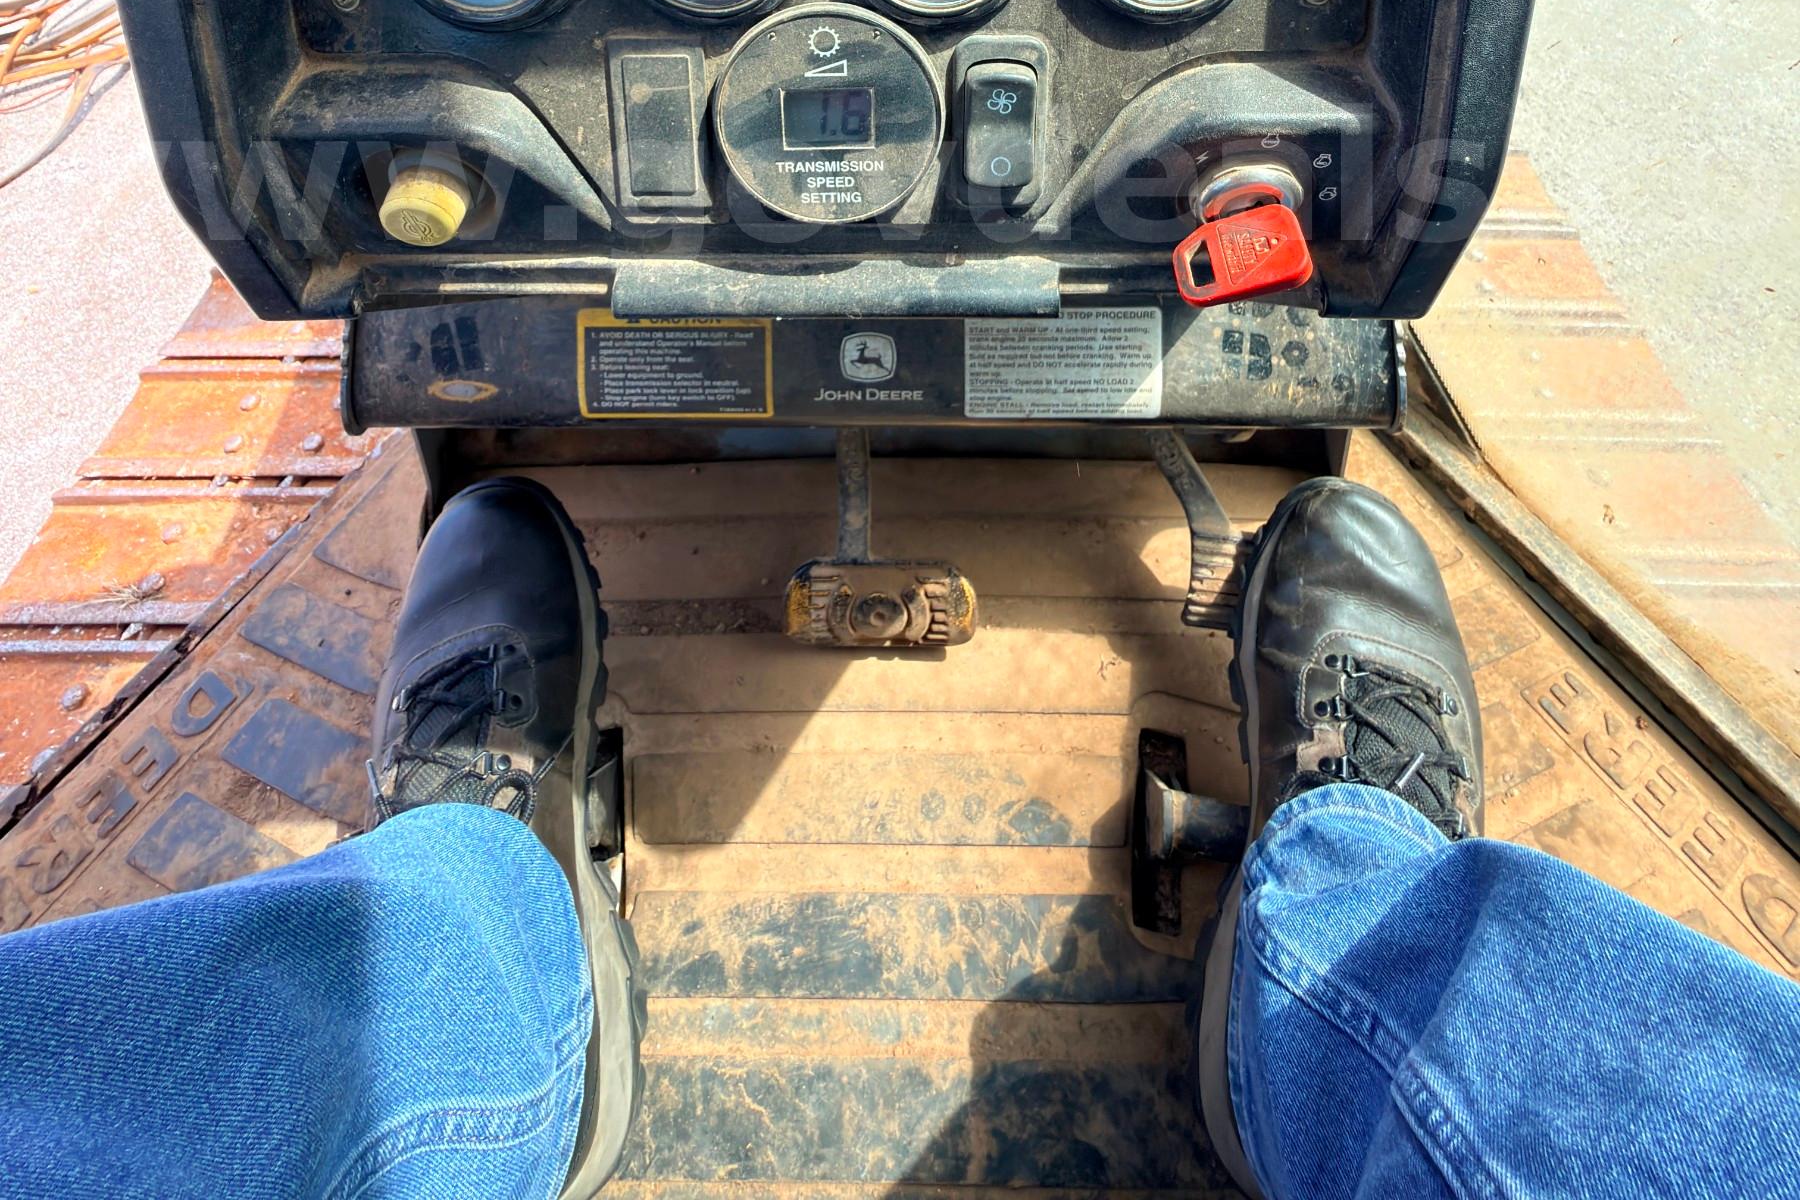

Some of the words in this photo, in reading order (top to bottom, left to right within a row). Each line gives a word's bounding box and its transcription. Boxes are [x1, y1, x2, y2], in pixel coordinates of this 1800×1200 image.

[776, 161, 884, 173] TRANSMISSION
[807, 177, 855, 188] SPEED
[801, 192, 862, 203] SETTING
[1067, 311, 1092, 320] STOP
[1096, 311, 1156, 320] PROCEDURE
[814, 388, 862, 401] JOHN
[867, 388, 925, 401] DEERE
